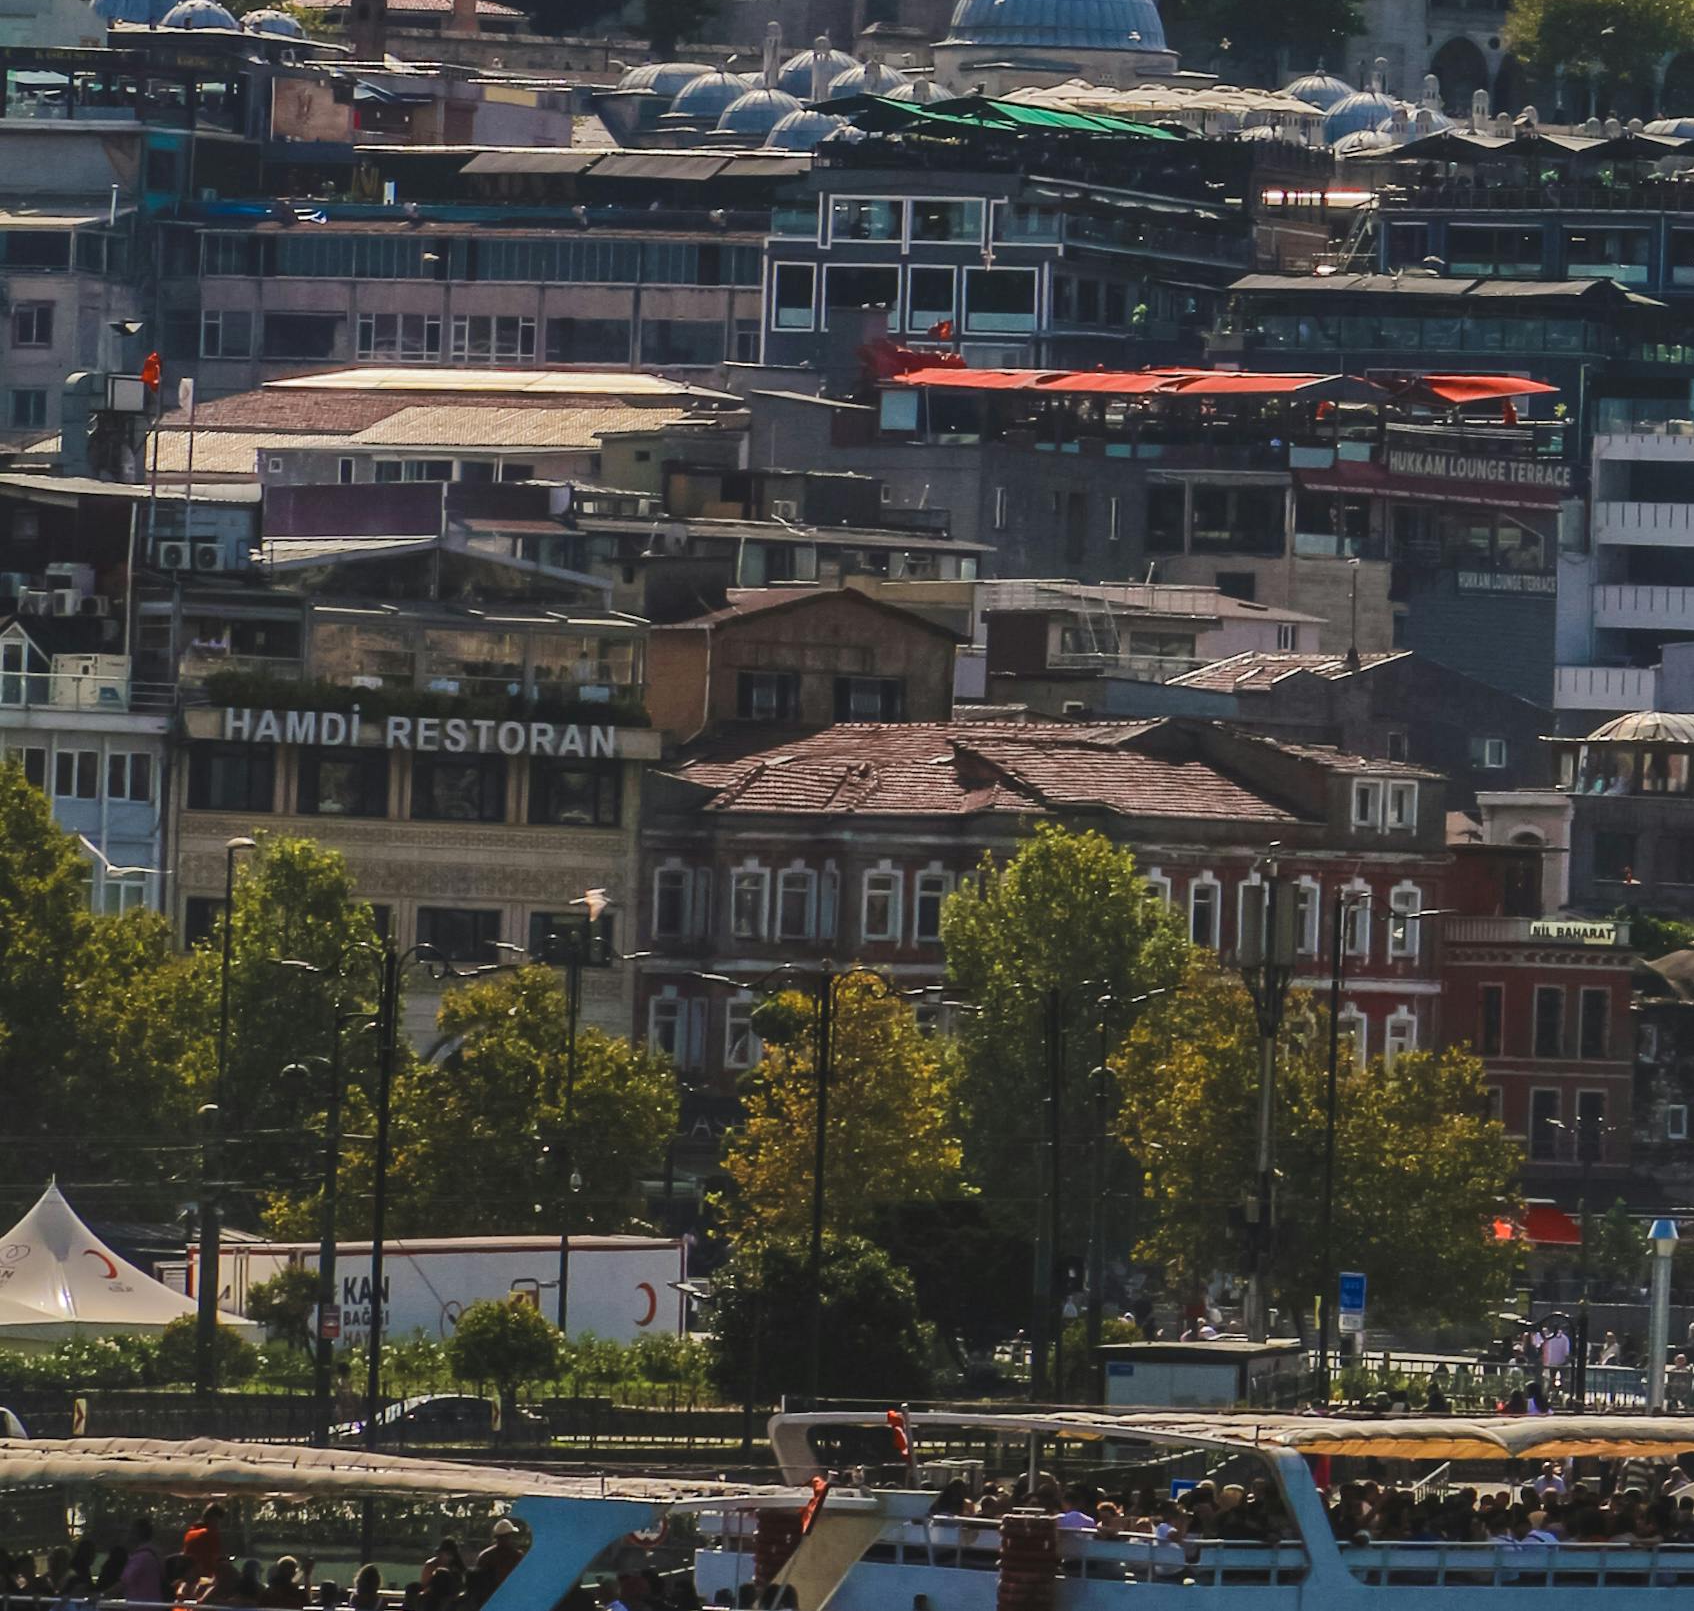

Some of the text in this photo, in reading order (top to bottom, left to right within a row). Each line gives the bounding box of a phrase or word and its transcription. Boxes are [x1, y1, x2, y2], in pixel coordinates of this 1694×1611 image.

[1389, 450, 1571, 487] HUKKAM LOUNGE TERRACE
[224, 703, 615, 759] HAMDİ RESTORAN
[1533, 924, 1615, 939] NİL BAHARAT
